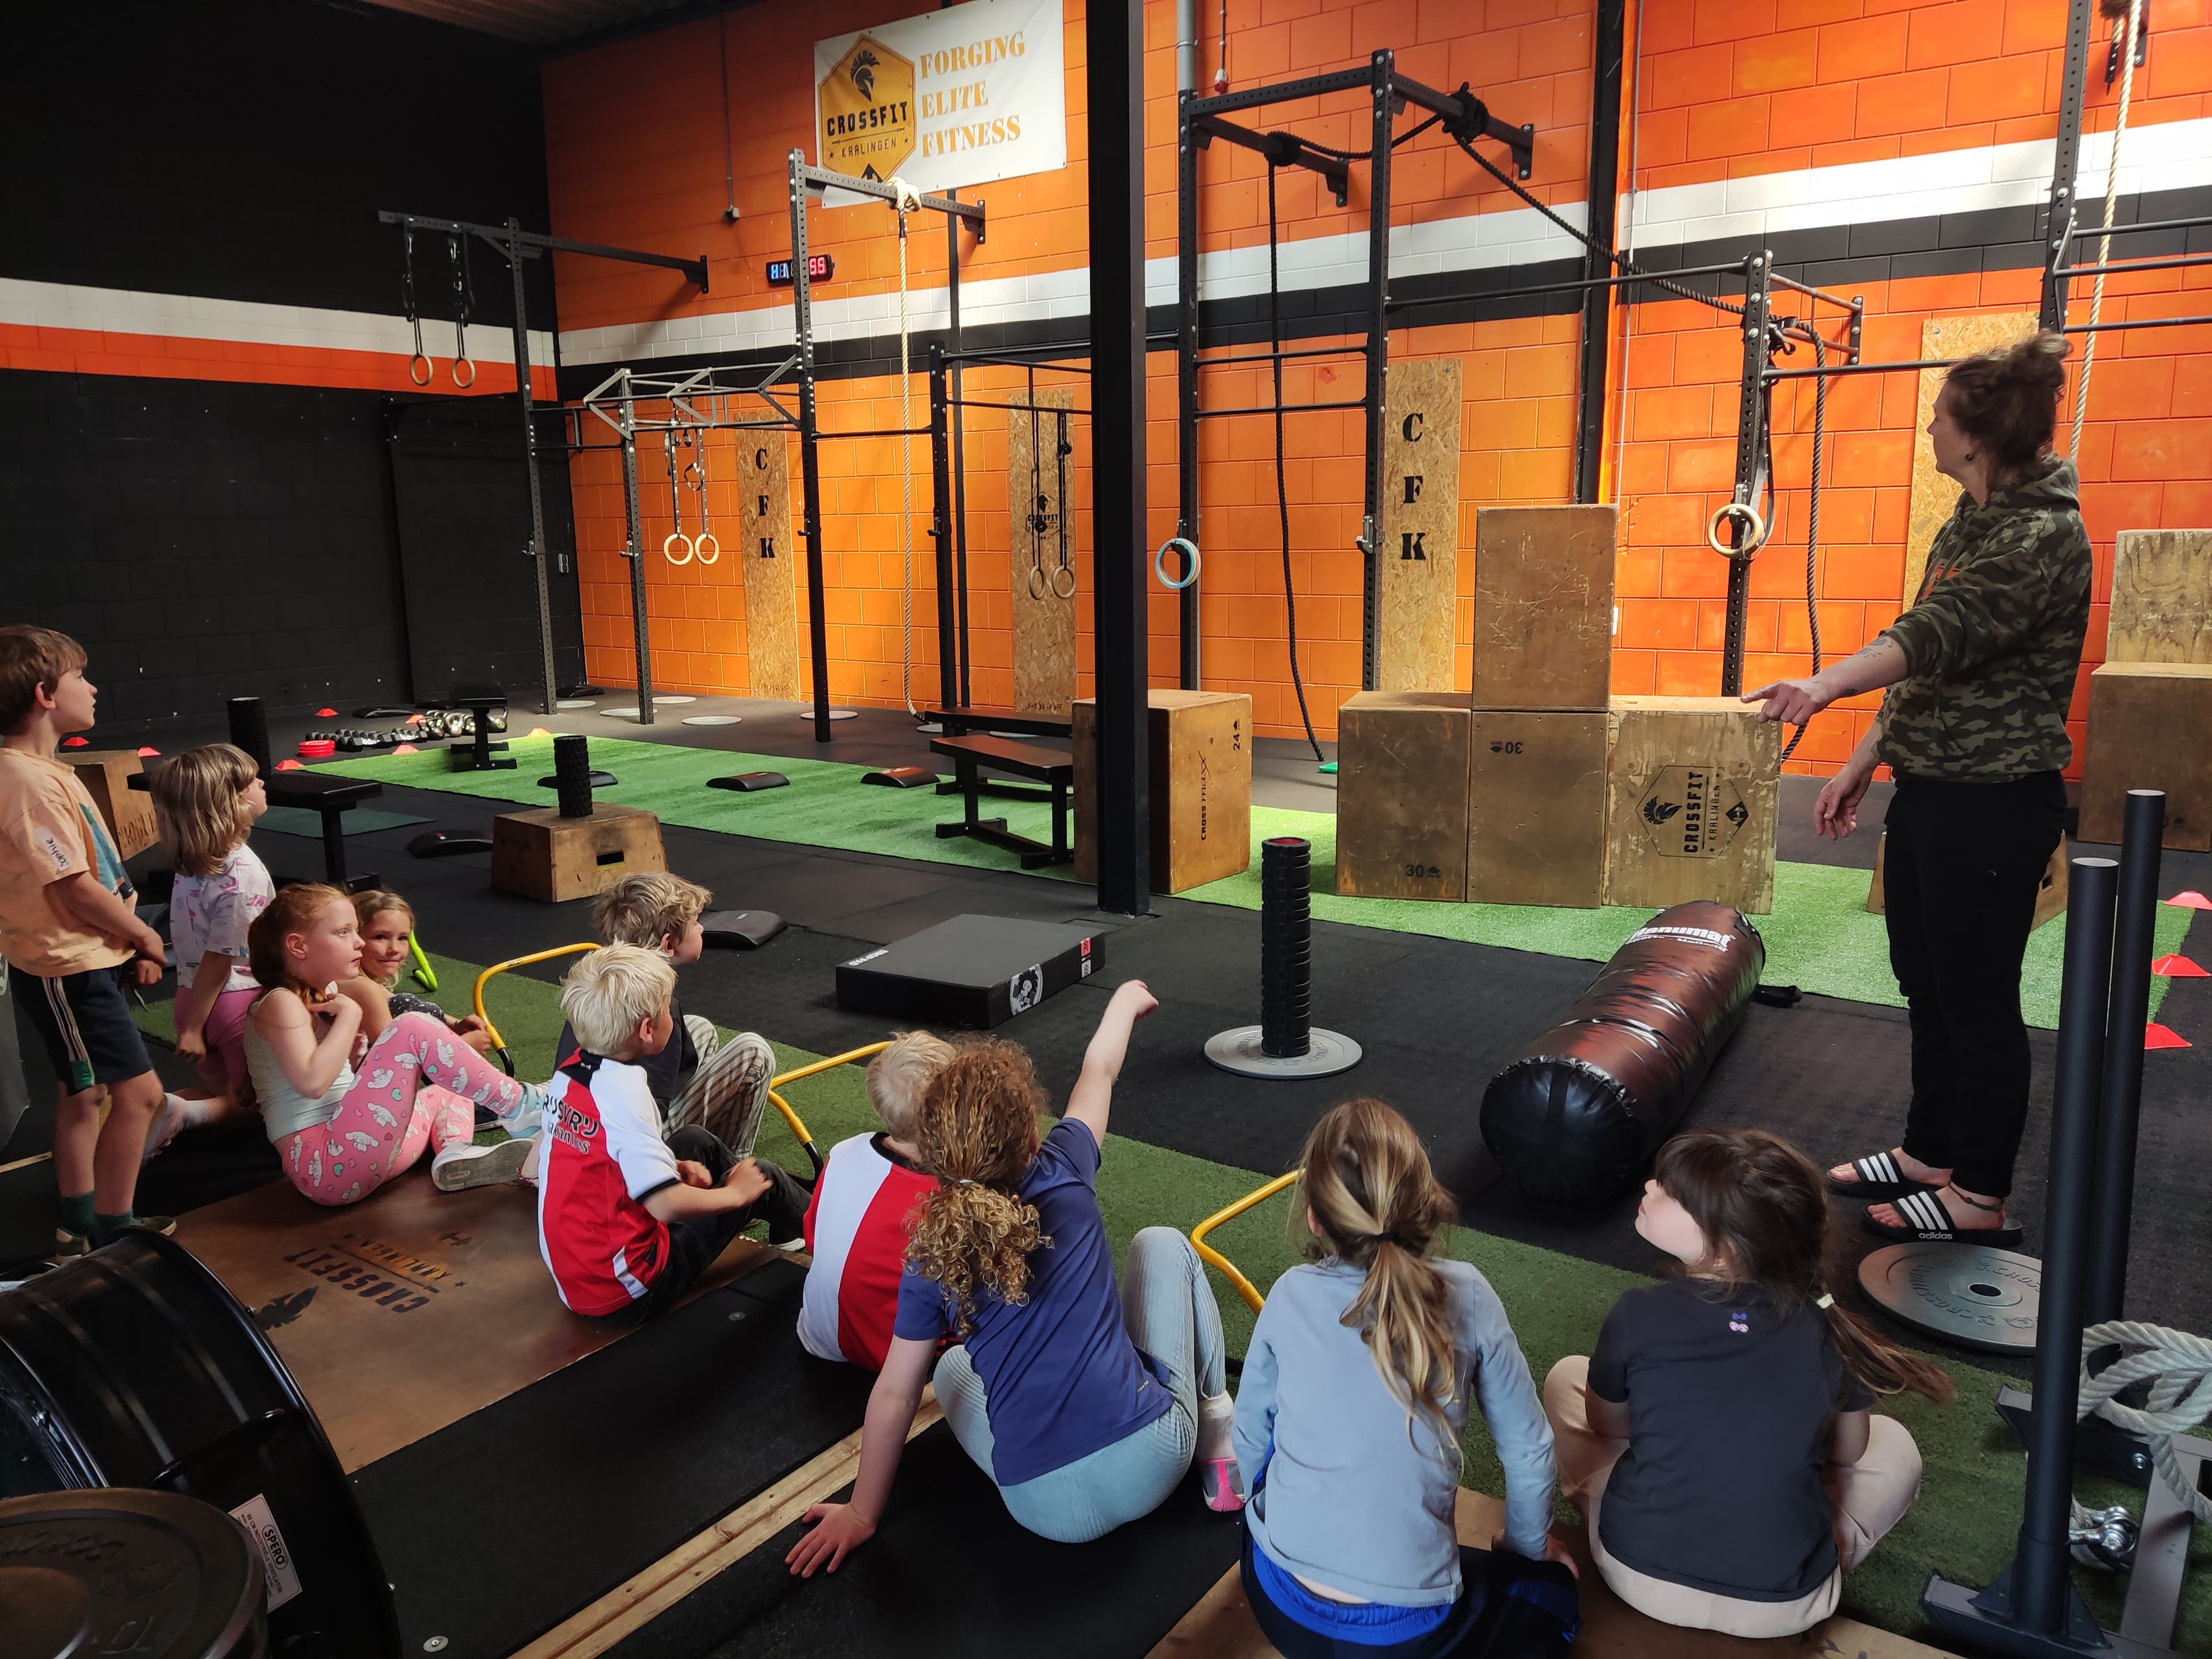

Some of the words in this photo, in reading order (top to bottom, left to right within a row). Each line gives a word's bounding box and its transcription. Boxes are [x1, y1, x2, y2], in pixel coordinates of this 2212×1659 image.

[919, 30, 1026, 79] FORGING
[921, 80, 988, 119] ELITE
[827, 101, 907, 137] CROSSFIT
[922, 115, 1021, 158] FITNESS
[841, 138, 897, 158] KRALINGEN
[1233, 733, 1240, 751] 24
[1505, 741, 1524, 755] 30
[1684, 772, 1703, 853] CROSSFIT
[1405, 864, 1424, 877] 30
[1918, 1232, 1953, 1240] adidas
[283, 1248, 431, 1313] CROSSFIT
[264, 1529, 285, 1565] SPERO
